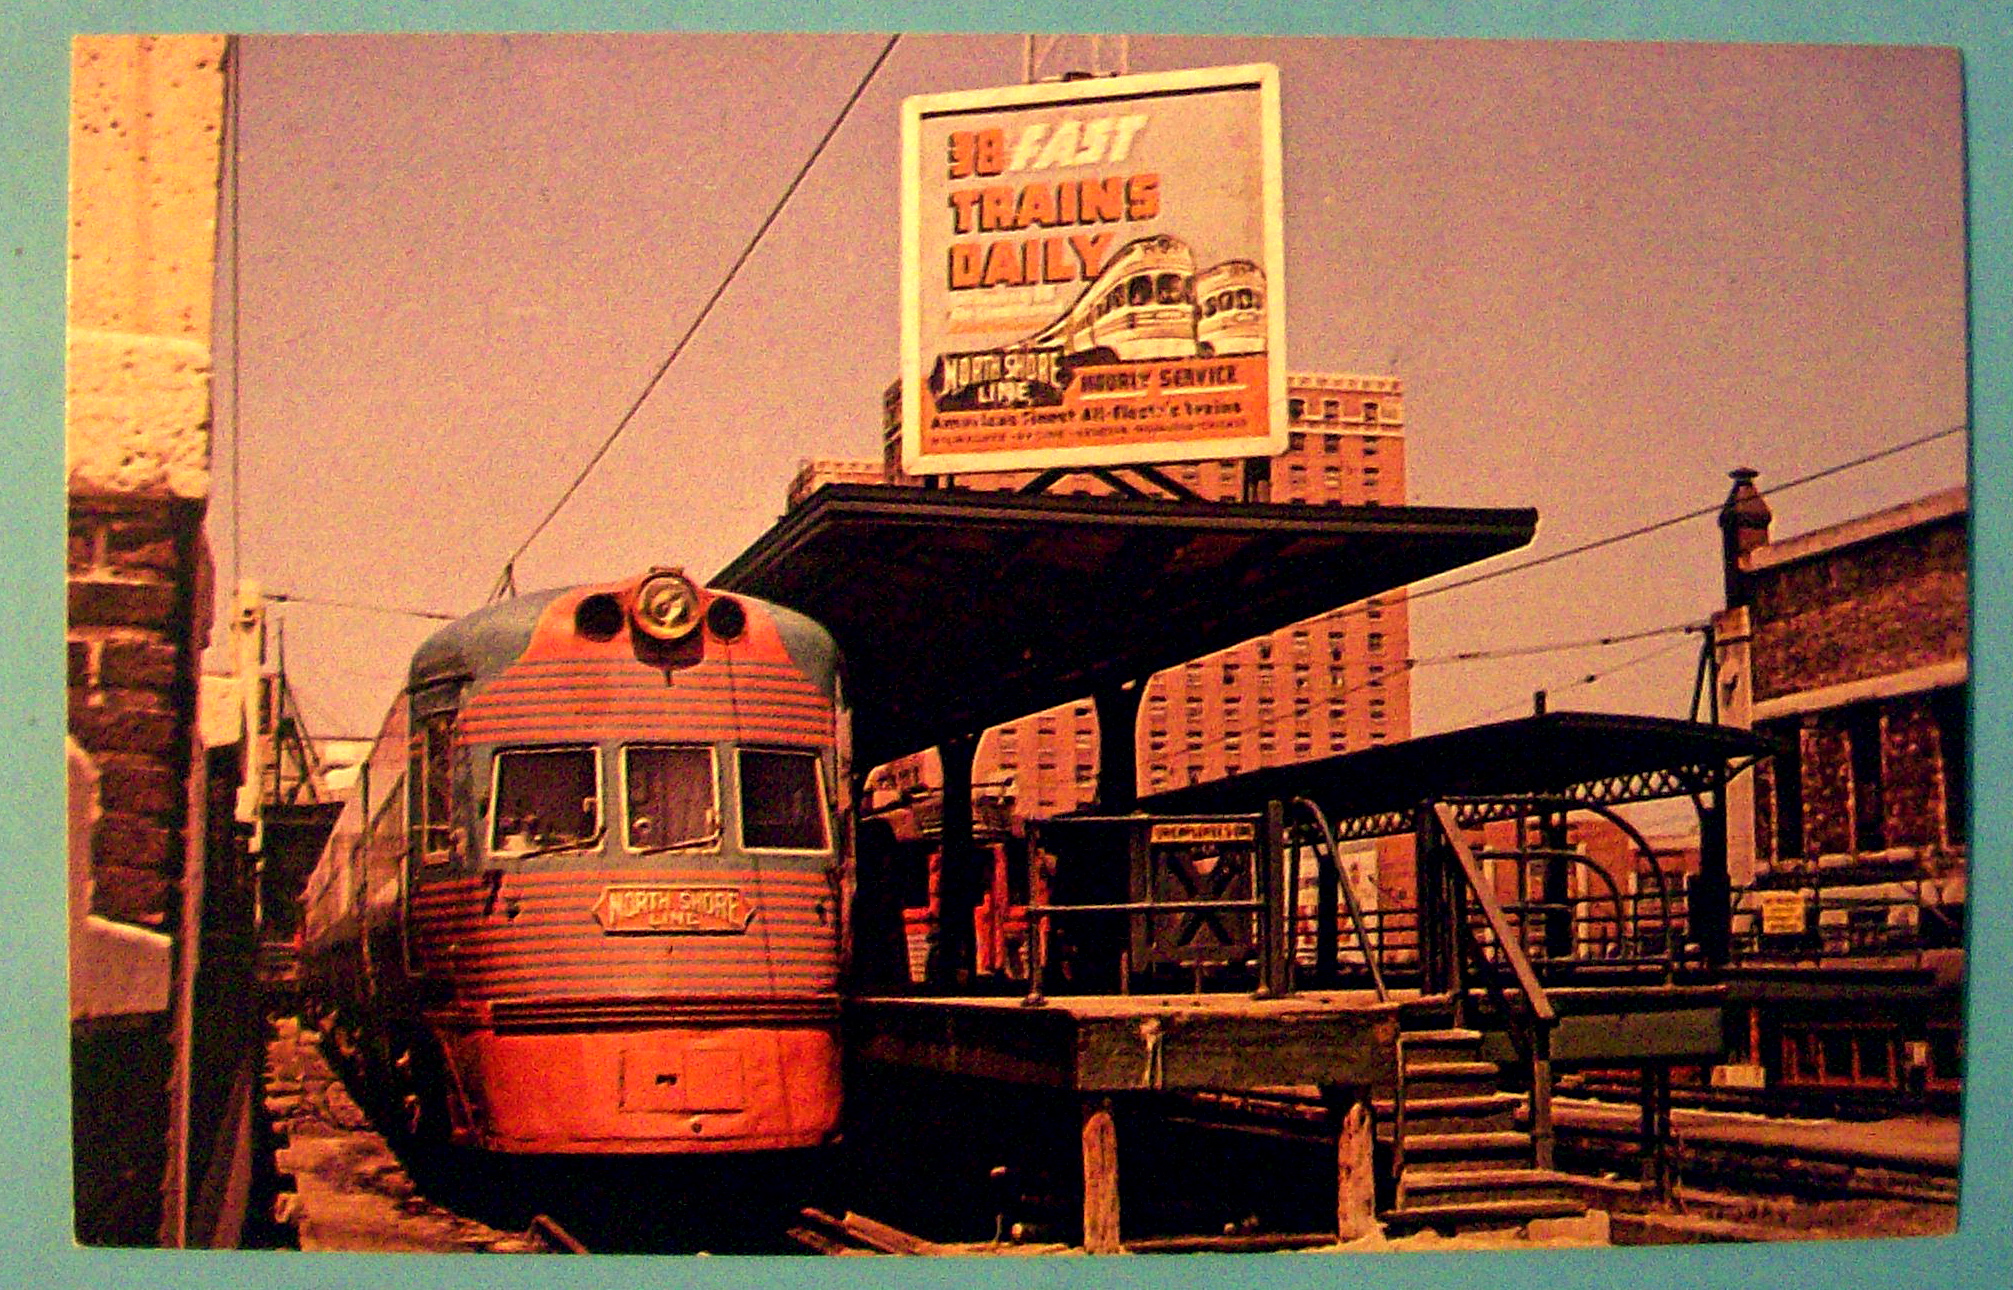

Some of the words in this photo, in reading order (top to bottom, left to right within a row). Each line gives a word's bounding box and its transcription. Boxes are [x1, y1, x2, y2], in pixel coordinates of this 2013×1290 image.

[1009, 115, 1149, 171] FAST
[949, 174, 1161, 235] TRAINS
[948, 233, 1116, 290] DAILY
[941, 356, 1000, 395] NORTH
[977, 381, 1031, 403] LINE
[1160, 365, 1237, 387] SERVICE
[609, 891, 671, 925] NORTH
[680, 891, 739, 925] SHORE
[650, 912, 701, 925] LINE
